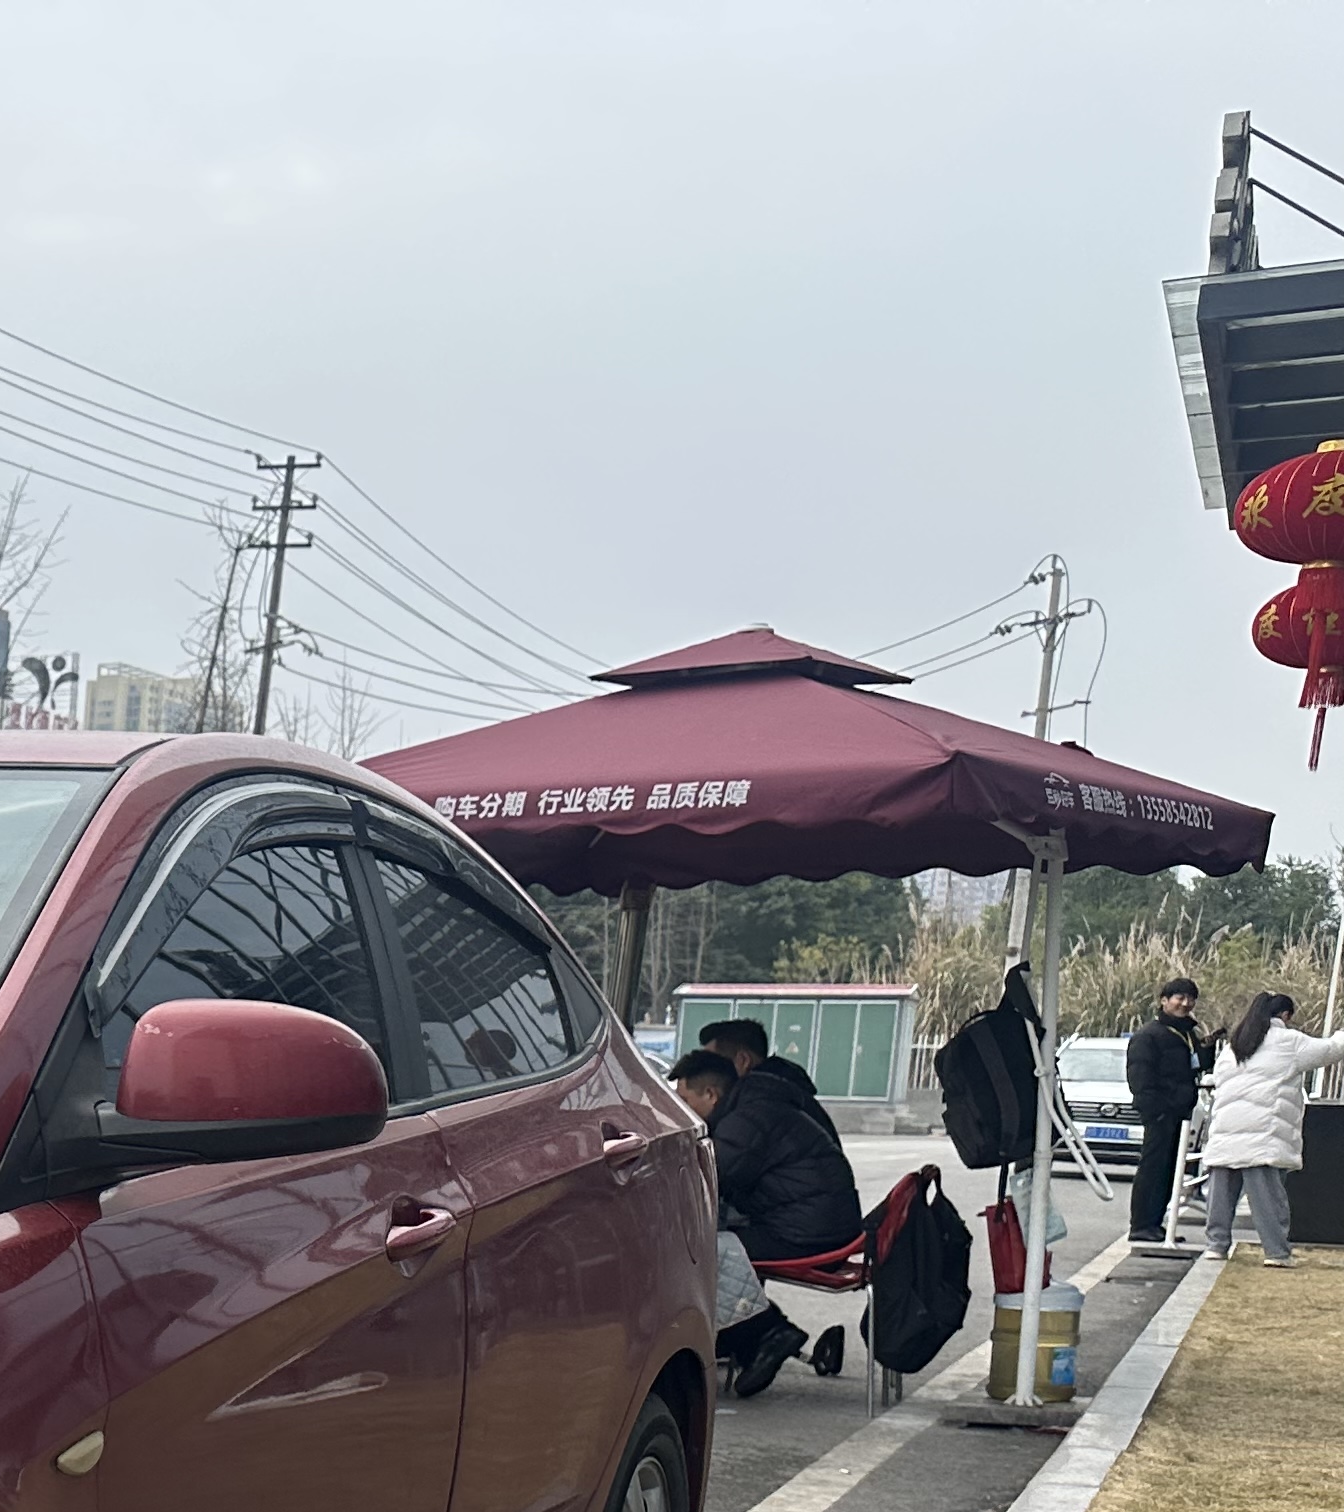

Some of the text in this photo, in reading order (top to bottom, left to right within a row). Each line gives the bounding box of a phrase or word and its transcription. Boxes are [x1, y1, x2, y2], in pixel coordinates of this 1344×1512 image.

[433, 779, 752, 821] 购车分期 行业领先 品质保障
